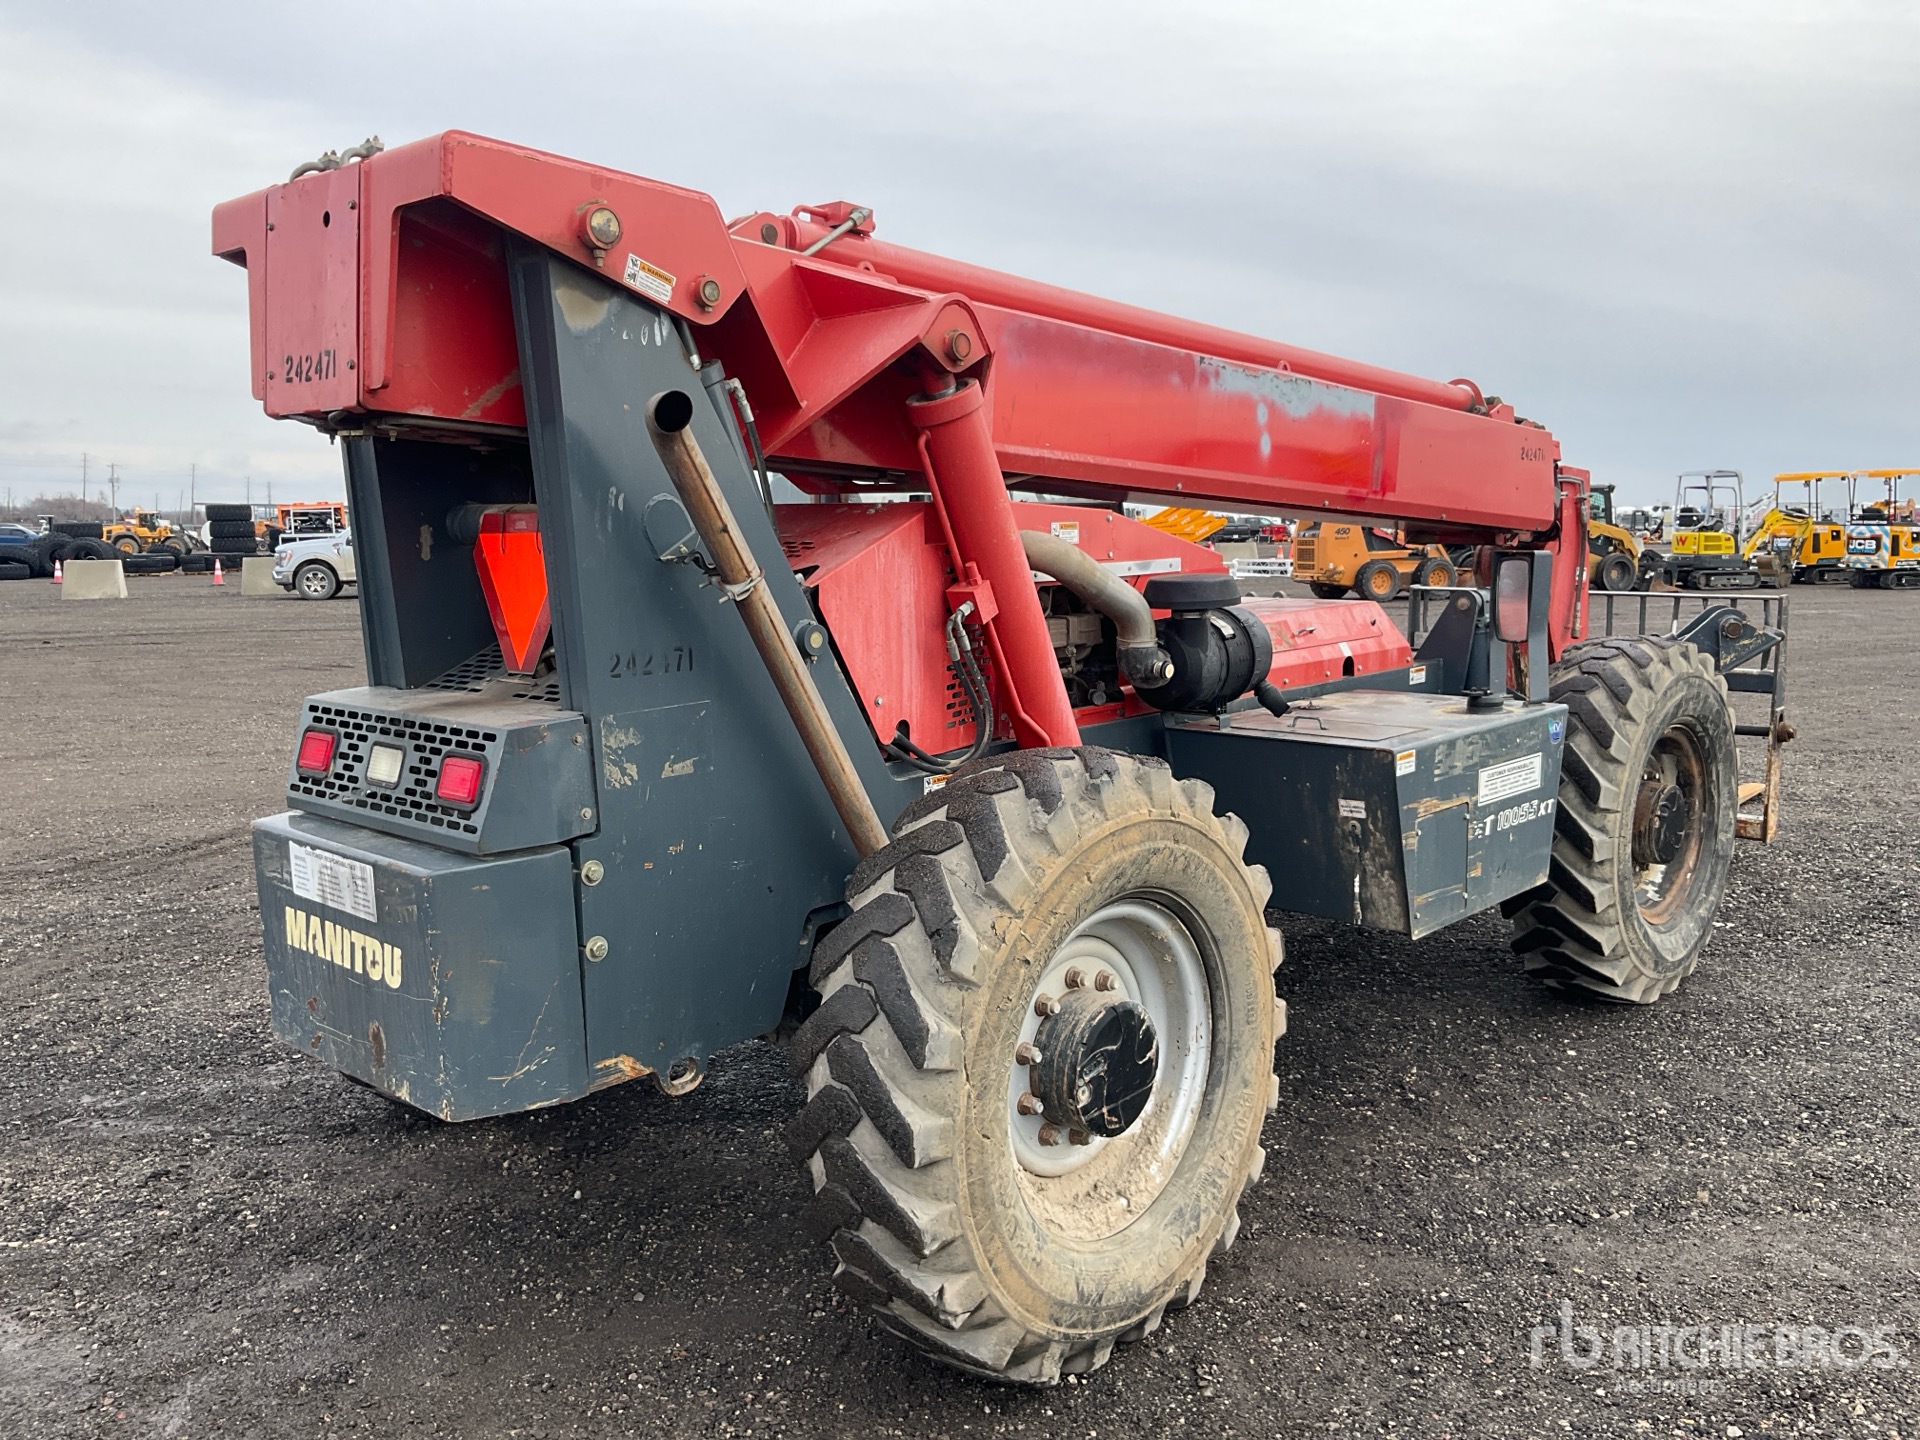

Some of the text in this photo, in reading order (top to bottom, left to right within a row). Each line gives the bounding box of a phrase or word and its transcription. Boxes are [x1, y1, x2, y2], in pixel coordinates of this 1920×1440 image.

[647, 266, 671, 284] WARNING
[285, 349, 336, 383] 242471
[1335, 527, 1351, 535] 450
[1849, 539, 1876, 548] JCB
[285, 906, 402, 989] MANITOU
